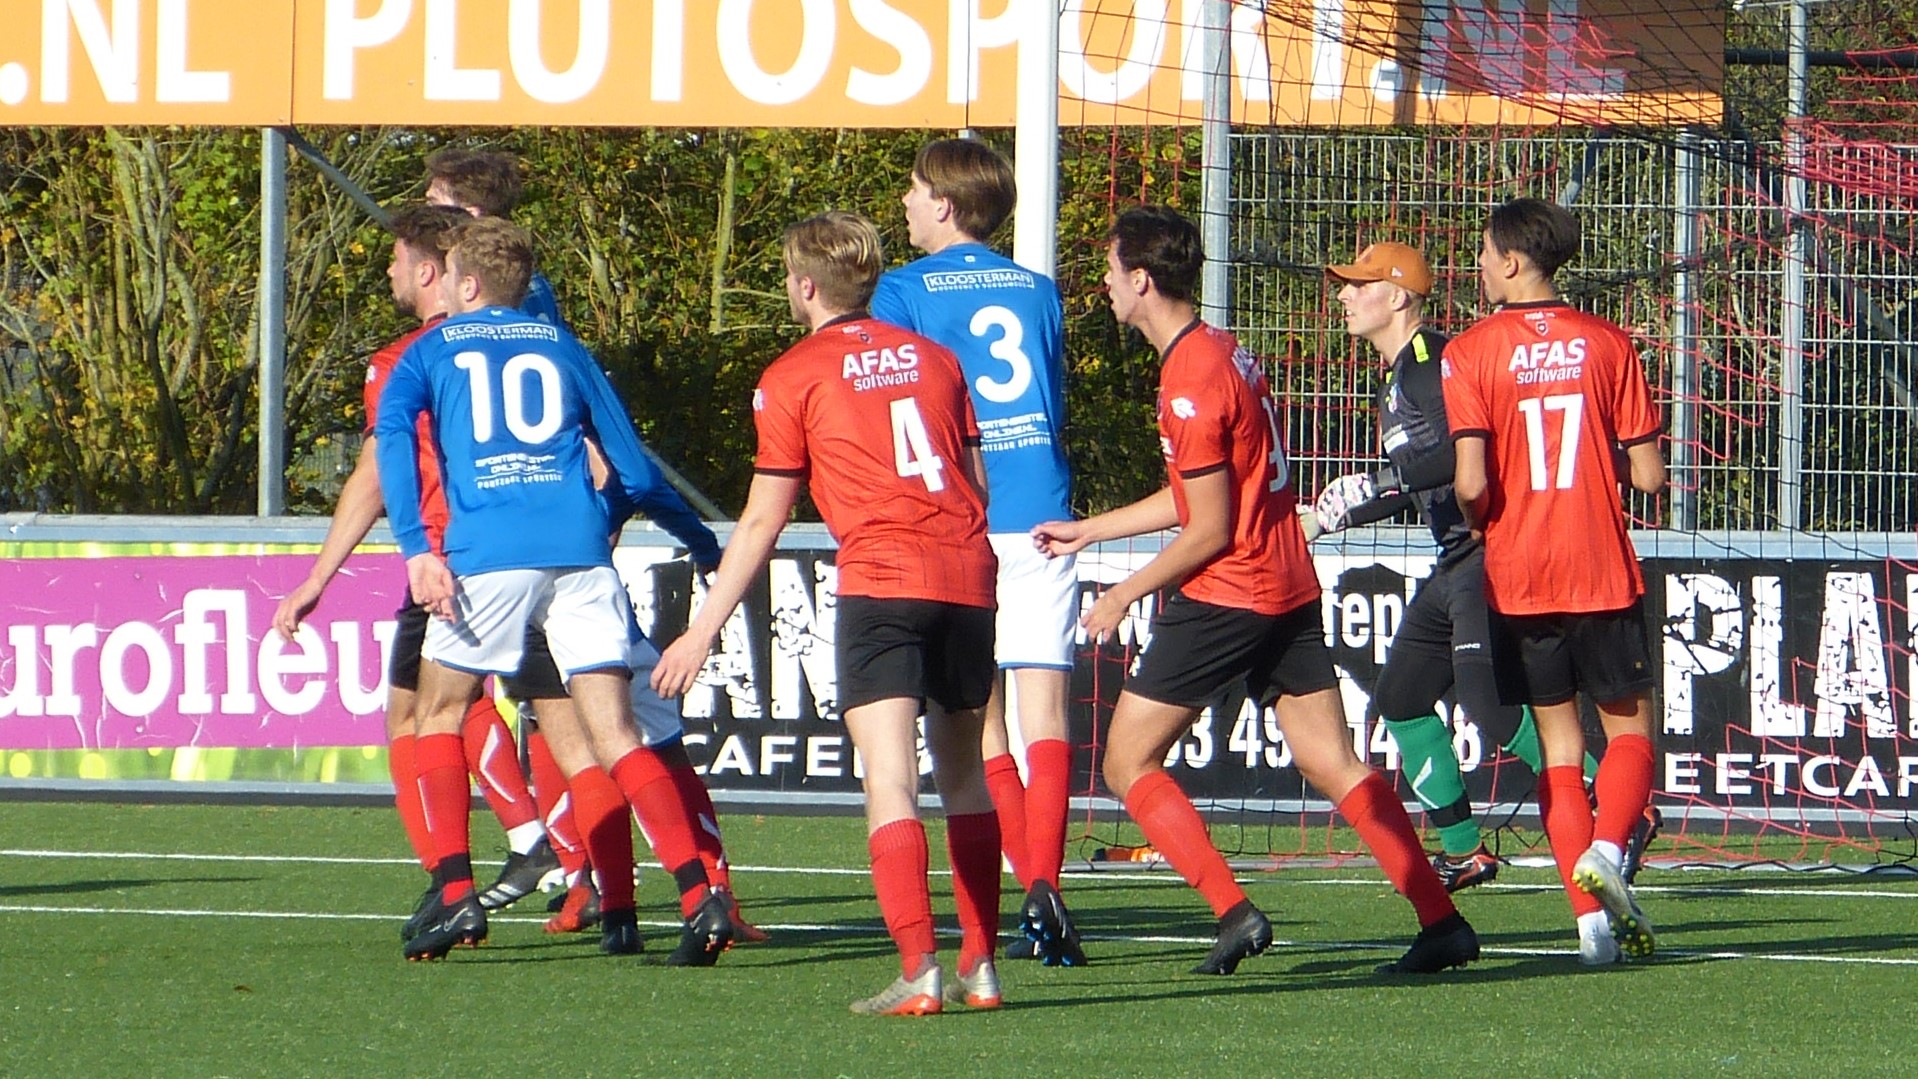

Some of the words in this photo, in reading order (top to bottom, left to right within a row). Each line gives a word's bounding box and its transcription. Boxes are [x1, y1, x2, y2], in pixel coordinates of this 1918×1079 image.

[929, 272, 1031, 287] KLOOSTERMAN
[446, 326, 553, 337] KLOOSTERMAN
[842, 344, 919, 379] AFAS
[970, 305, 1032, 403] 3
[1508, 338, 1587, 371] AFAS
[853, 369, 919, 392] software
[1516, 366, 1582, 385] software
[454, 351, 562, 444] 10
[890, 397, 945, 493] 4
[1518, 393, 1584, 491] 17
[1662, 572, 1918, 739] PLA
